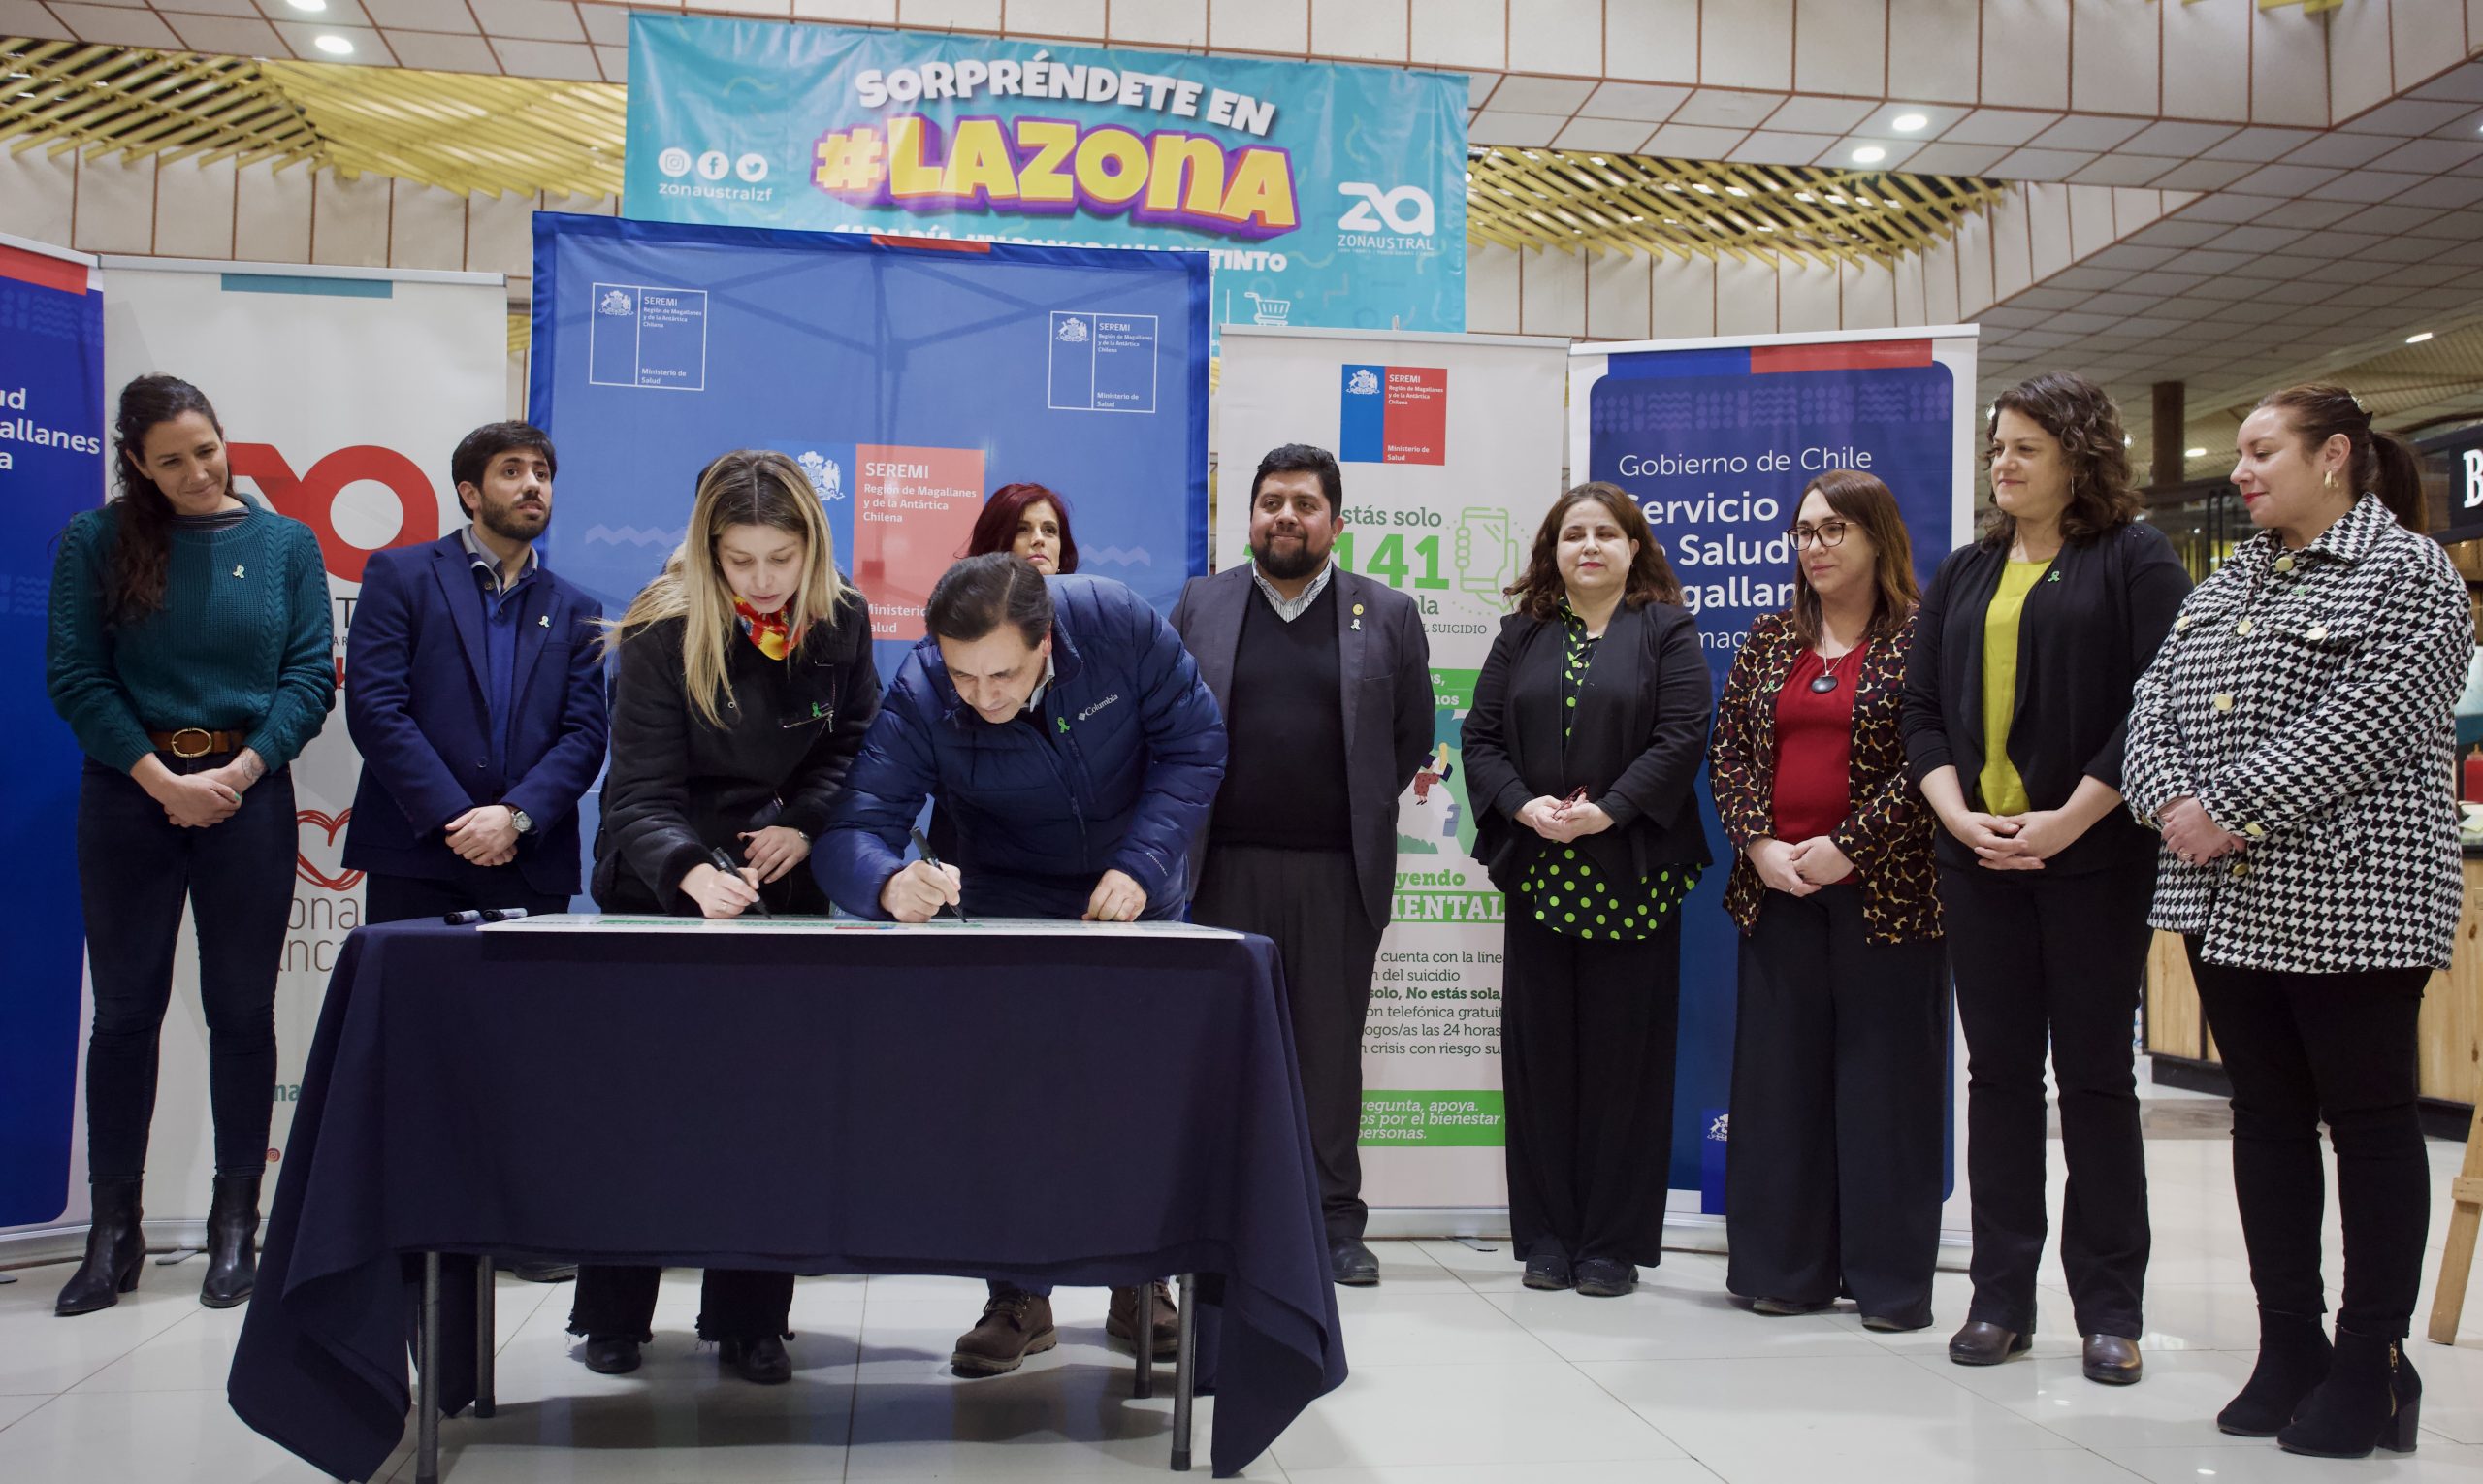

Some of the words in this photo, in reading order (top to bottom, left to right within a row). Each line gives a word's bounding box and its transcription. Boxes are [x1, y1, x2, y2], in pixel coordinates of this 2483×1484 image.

[855, 49, 1203, 116] SORPRÉNDETE
[1206, 88, 1275, 136] EN
[658, 183, 773, 202] zonaustralzf
[1338, 235, 1435, 250] ZONAUSTRAL
[644, 296, 678, 306] SEREMI
[1099, 322, 1131, 332] SEREMI
[641, 368, 677, 377] Ministerio
[1389, 374, 1421, 383] SEREMI
[1097, 391, 1130, 400] Ministerio
[1619, 454, 1747, 476] Gobierno
[1757, 450, 1790, 472] de
[1800, 446, 1872, 470] Chile
[865, 462, 929, 479] SEREMI
[863, 483, 899, 495] Región
[902, 486, 915, 495] de
[917, 486, 977, 498] Magallanes
[863, 500, 870, 509] y
[872, 499, 886, 507] de
[887, 499, 897, 508] la
[899, 500, 949, 511] Antártica
[1627, 491, 1779, 525] ervicio
[863, 511, 903, 523] Chilena
[1393, 507, 1442, 528] solo
[1679, 532, 1789, 566] Salud
[1416, 595, 1439, 615] la
[1432, 623, 1488, 634] SUICIDIO
[1085, 694, 1119, 716] Columbia
[1380, 952, 1429, 963] cuenta
[1432, 952, 1458, 963] con
[1462, 951, 1473, 963] la
[1477, 951, 1503, 964] líne
[1382, 969, 1403, 981] del
[1407, 969, 1460, 982] suicidio
[1405, 986, 1428, 999] No
[1431, 987, 1467, 1000] estás
[1387, 1005, 1455, 1018] telefónica
[1422, 1024, 1439, 1036] las
[1443, 1023, 1460, 1036] 24
[1464, 1024, 1502, 1036] horas
[1370, 1042, 1405, 1054] crisis
[1409, 1045, 1435, 1054] con
[1439, 1042, 1481, 1057] riesgo
[1429, 1101, 1479, 1114] apoya.
[1379, 1114, 1407, 1128] por
[1410, 1113, 1425, 1125] el
[1429, 1113, 1501, 1125] bienestar
